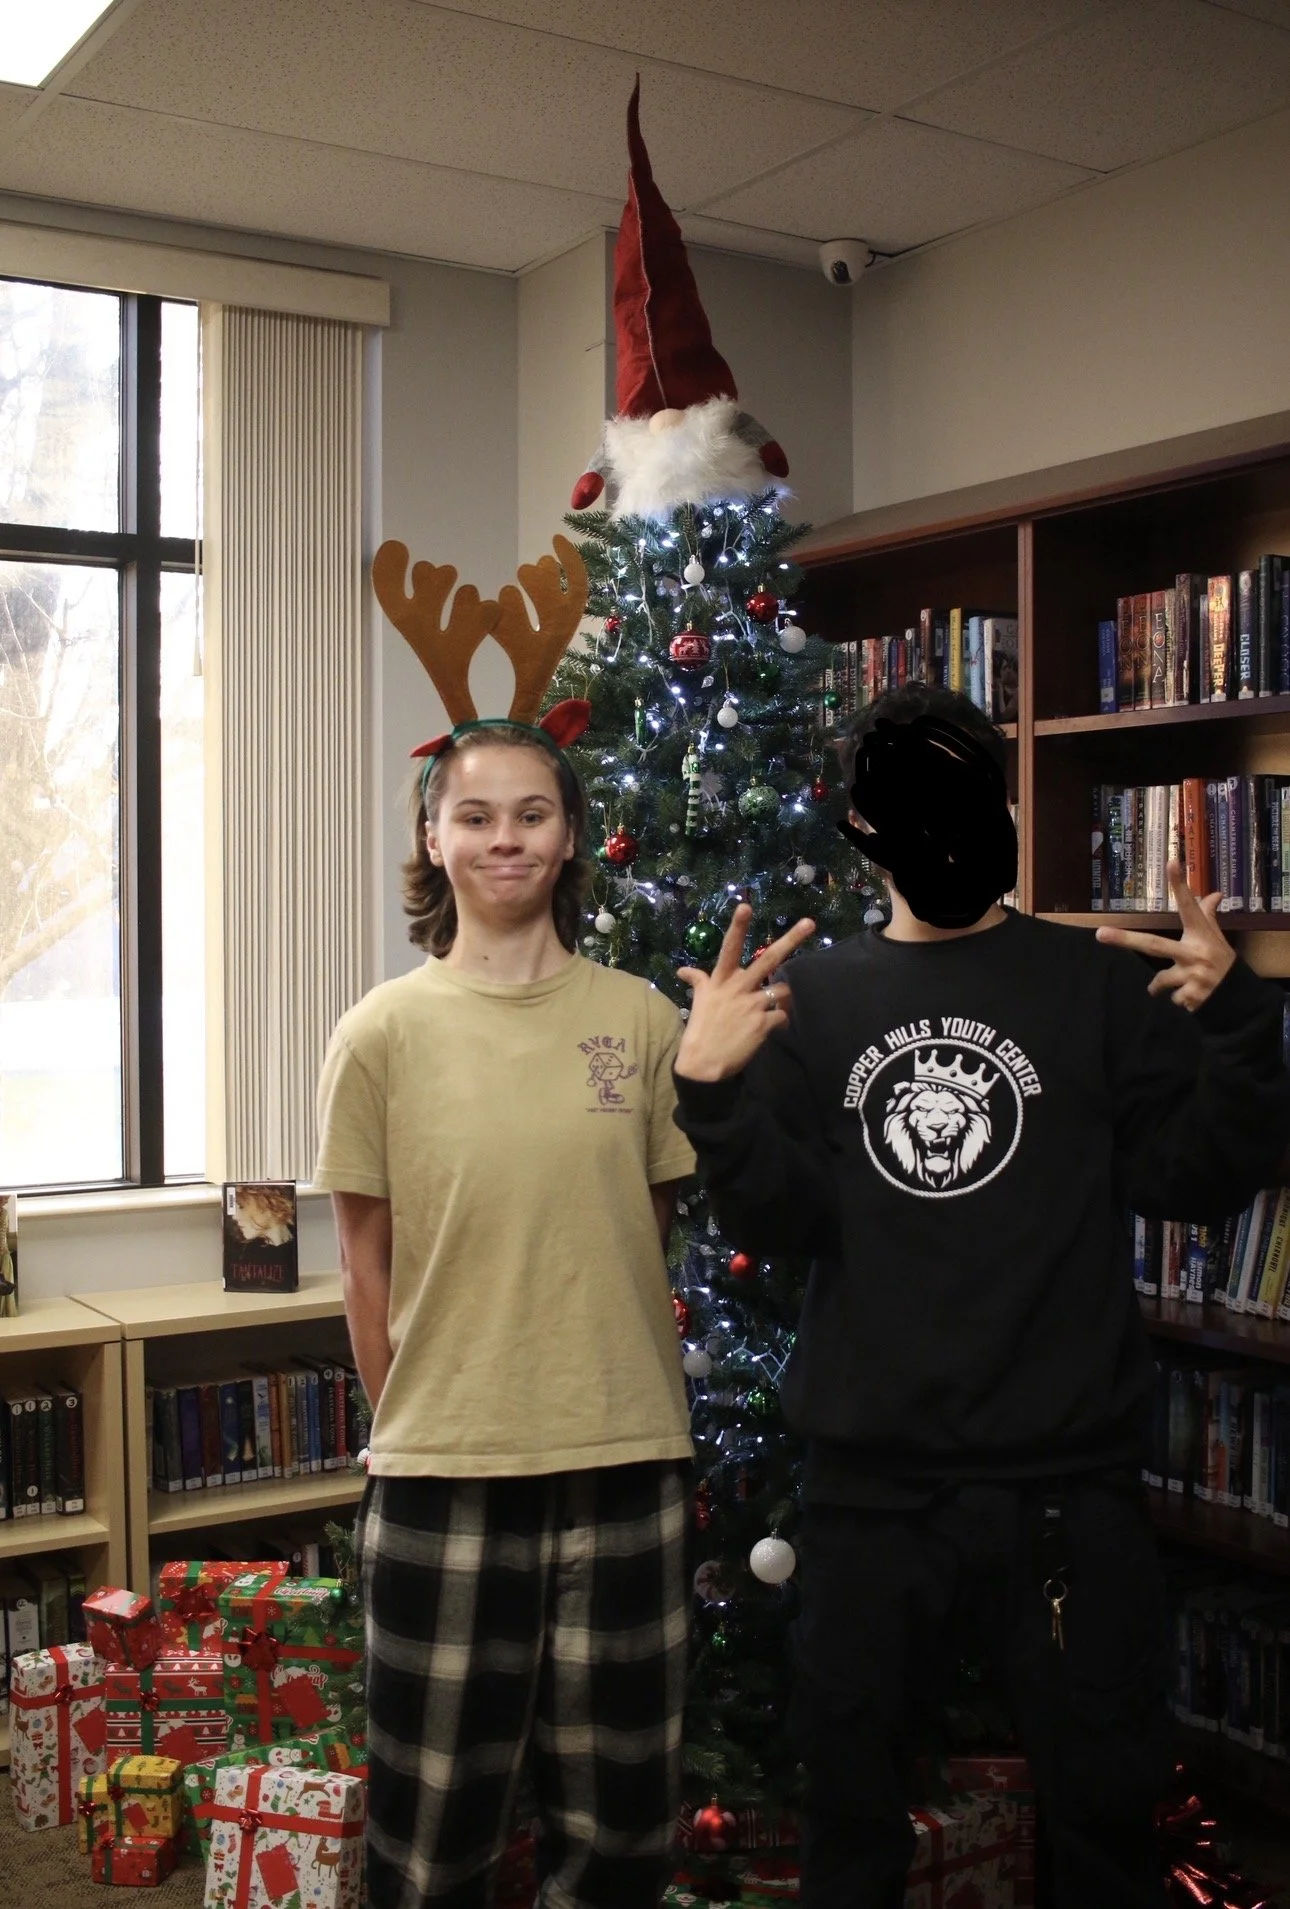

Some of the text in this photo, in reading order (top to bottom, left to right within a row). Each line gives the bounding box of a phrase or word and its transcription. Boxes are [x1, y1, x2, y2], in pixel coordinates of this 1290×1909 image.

[1212, 643, 1226, 687] DEEPER
[1239, 633, 1251, 680] CLOSER
[1271, 802, 1280, 827] PICTURE
[1271, 836, 1280, 852] DEAD
[843, 1017, 1043, 1109] COPPER HILLS YOUTH CENTER
[1268, 1236, 1283, 1273] CHERNOBYL
